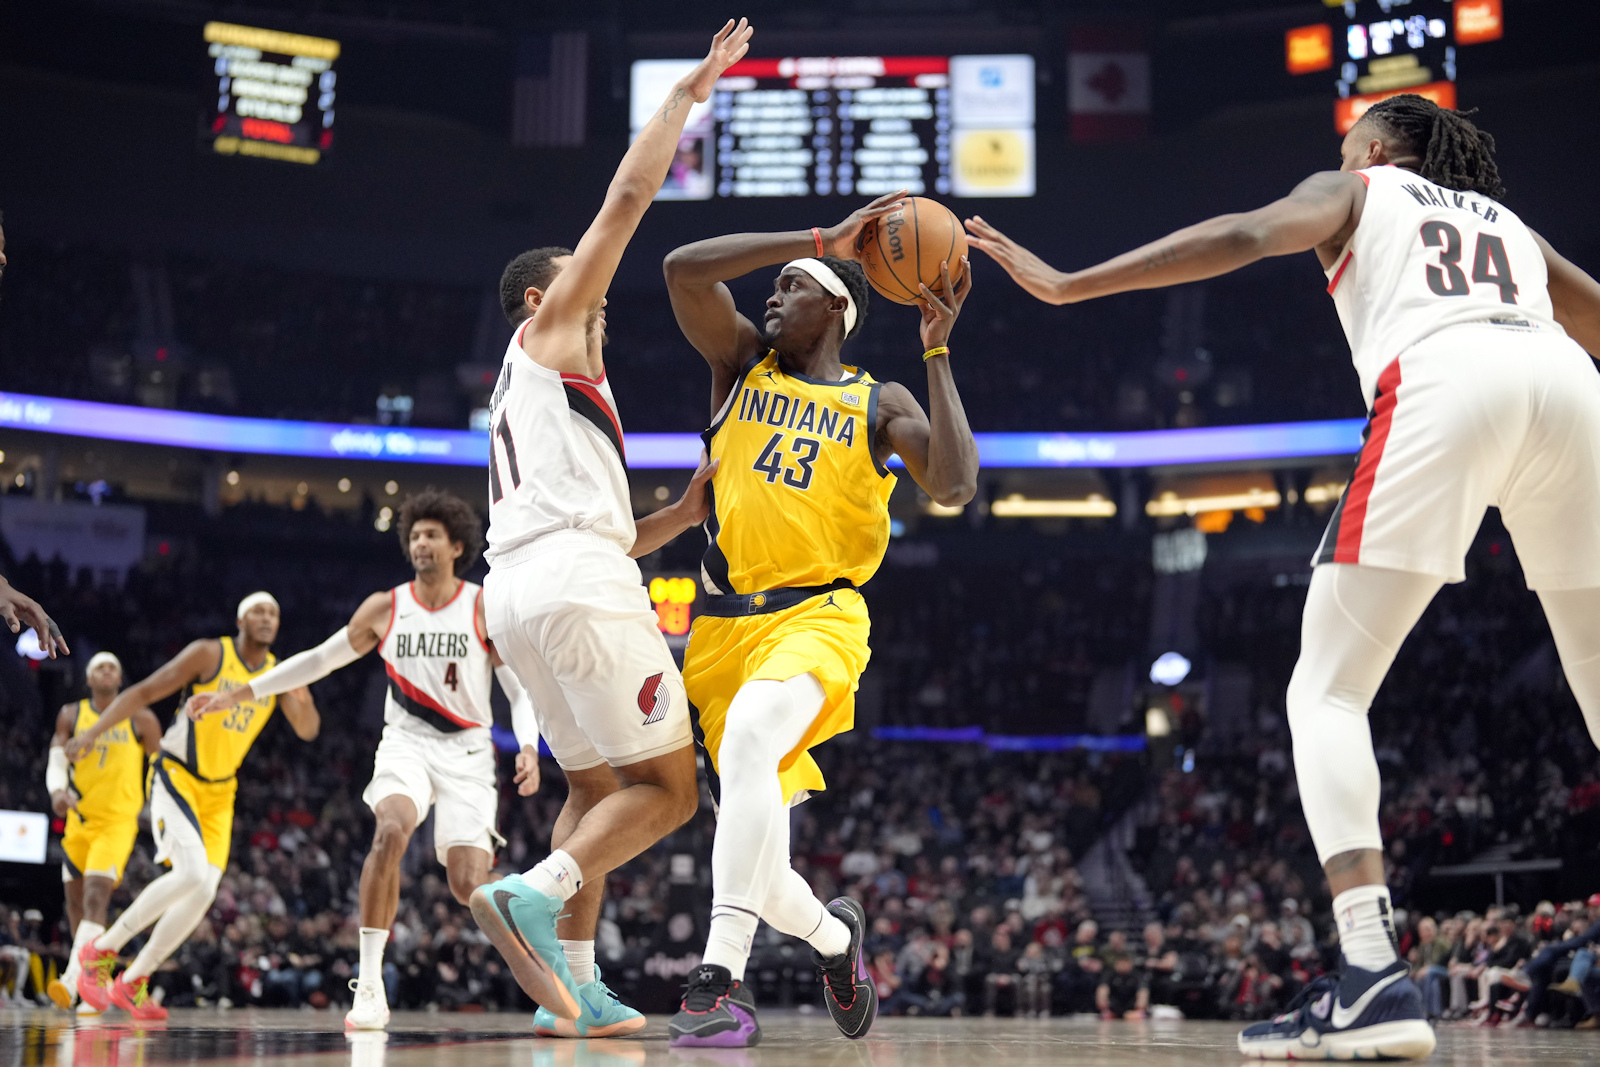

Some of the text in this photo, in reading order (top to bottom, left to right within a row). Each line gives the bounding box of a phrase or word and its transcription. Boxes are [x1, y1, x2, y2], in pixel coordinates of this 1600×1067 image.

[1400, 183, 1499, 223] WALKER
[1419, 220, 1519, 305] 34
[737, 387, 856, 448] INDIANA
[752, 432, 821, 490] 43
[396, 632, 469, 658] BLAZERS
[443, 662, 458, 692] 4
[221, 702, 255, 733] 33
[96, 745, 108, 769] 7
